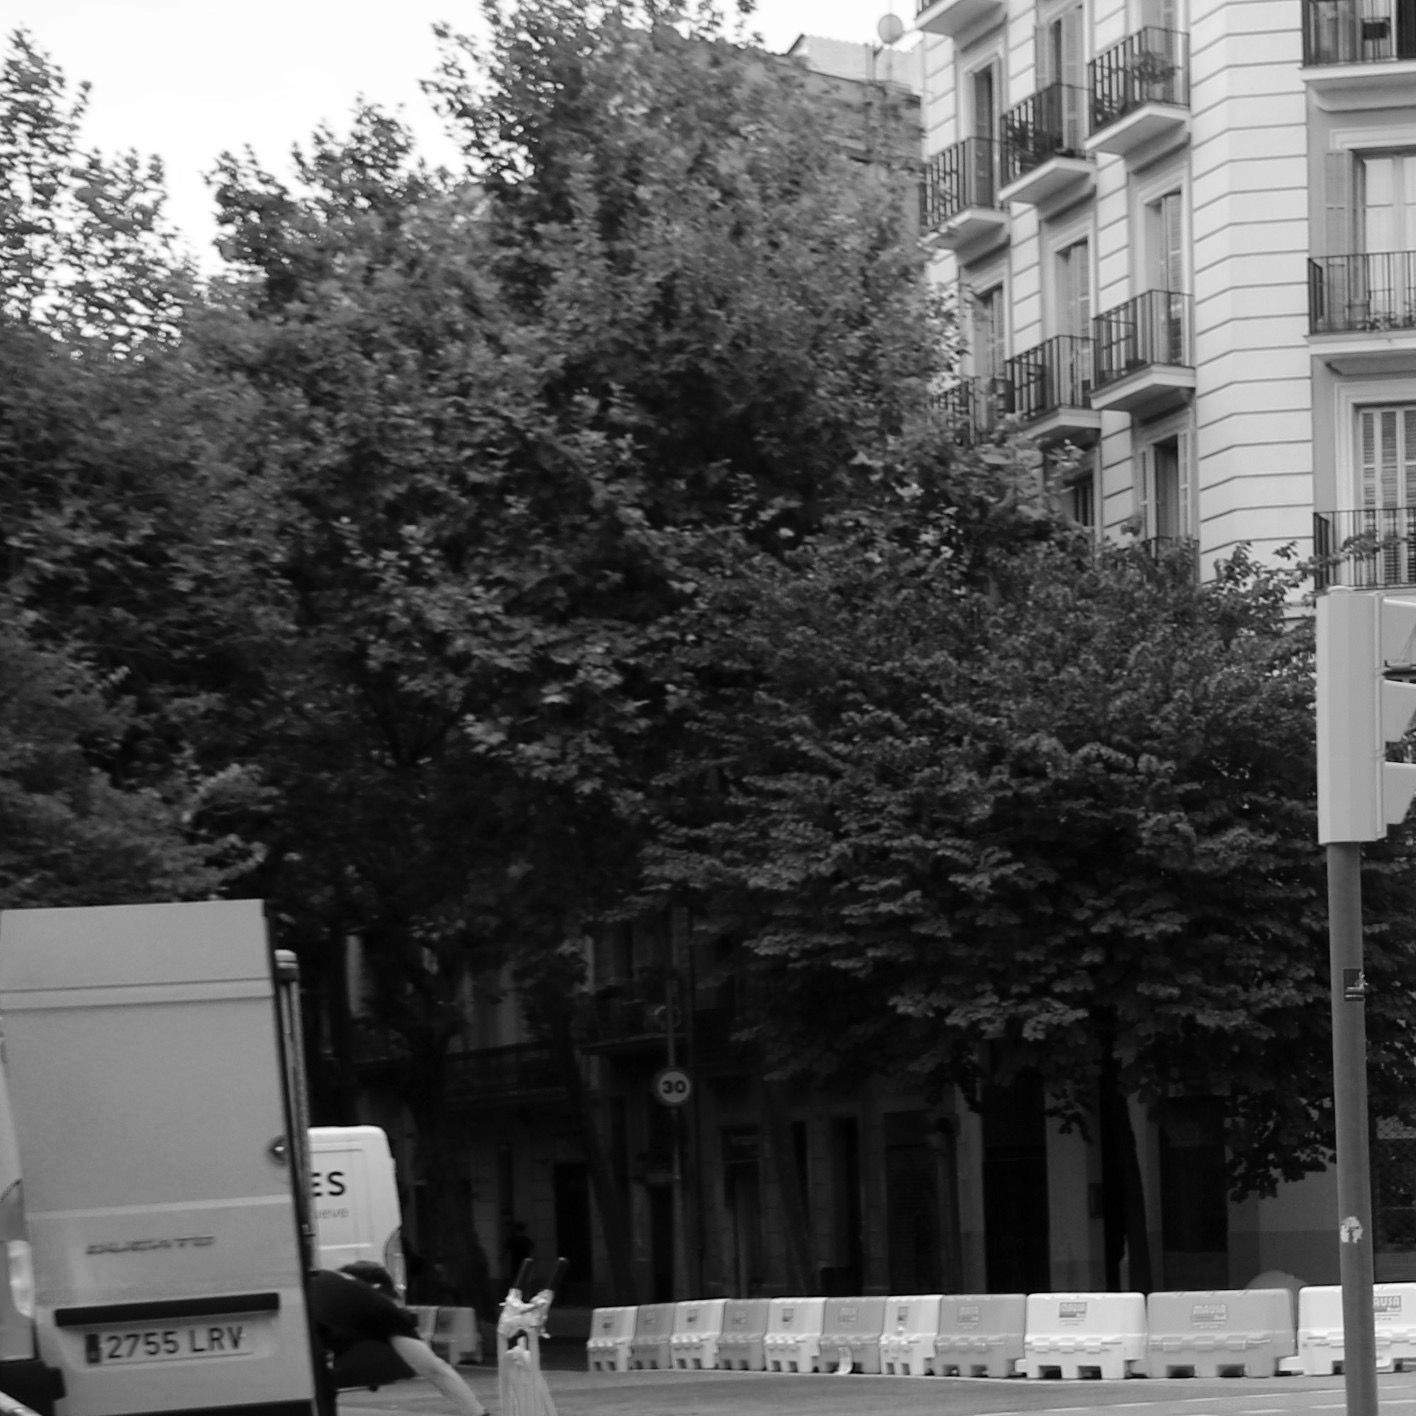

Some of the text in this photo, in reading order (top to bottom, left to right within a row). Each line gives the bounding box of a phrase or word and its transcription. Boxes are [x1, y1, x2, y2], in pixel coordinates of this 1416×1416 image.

[661, 1080, 688, 1094] 30
[106, 1325, 244, 1360] 2755 LRV
